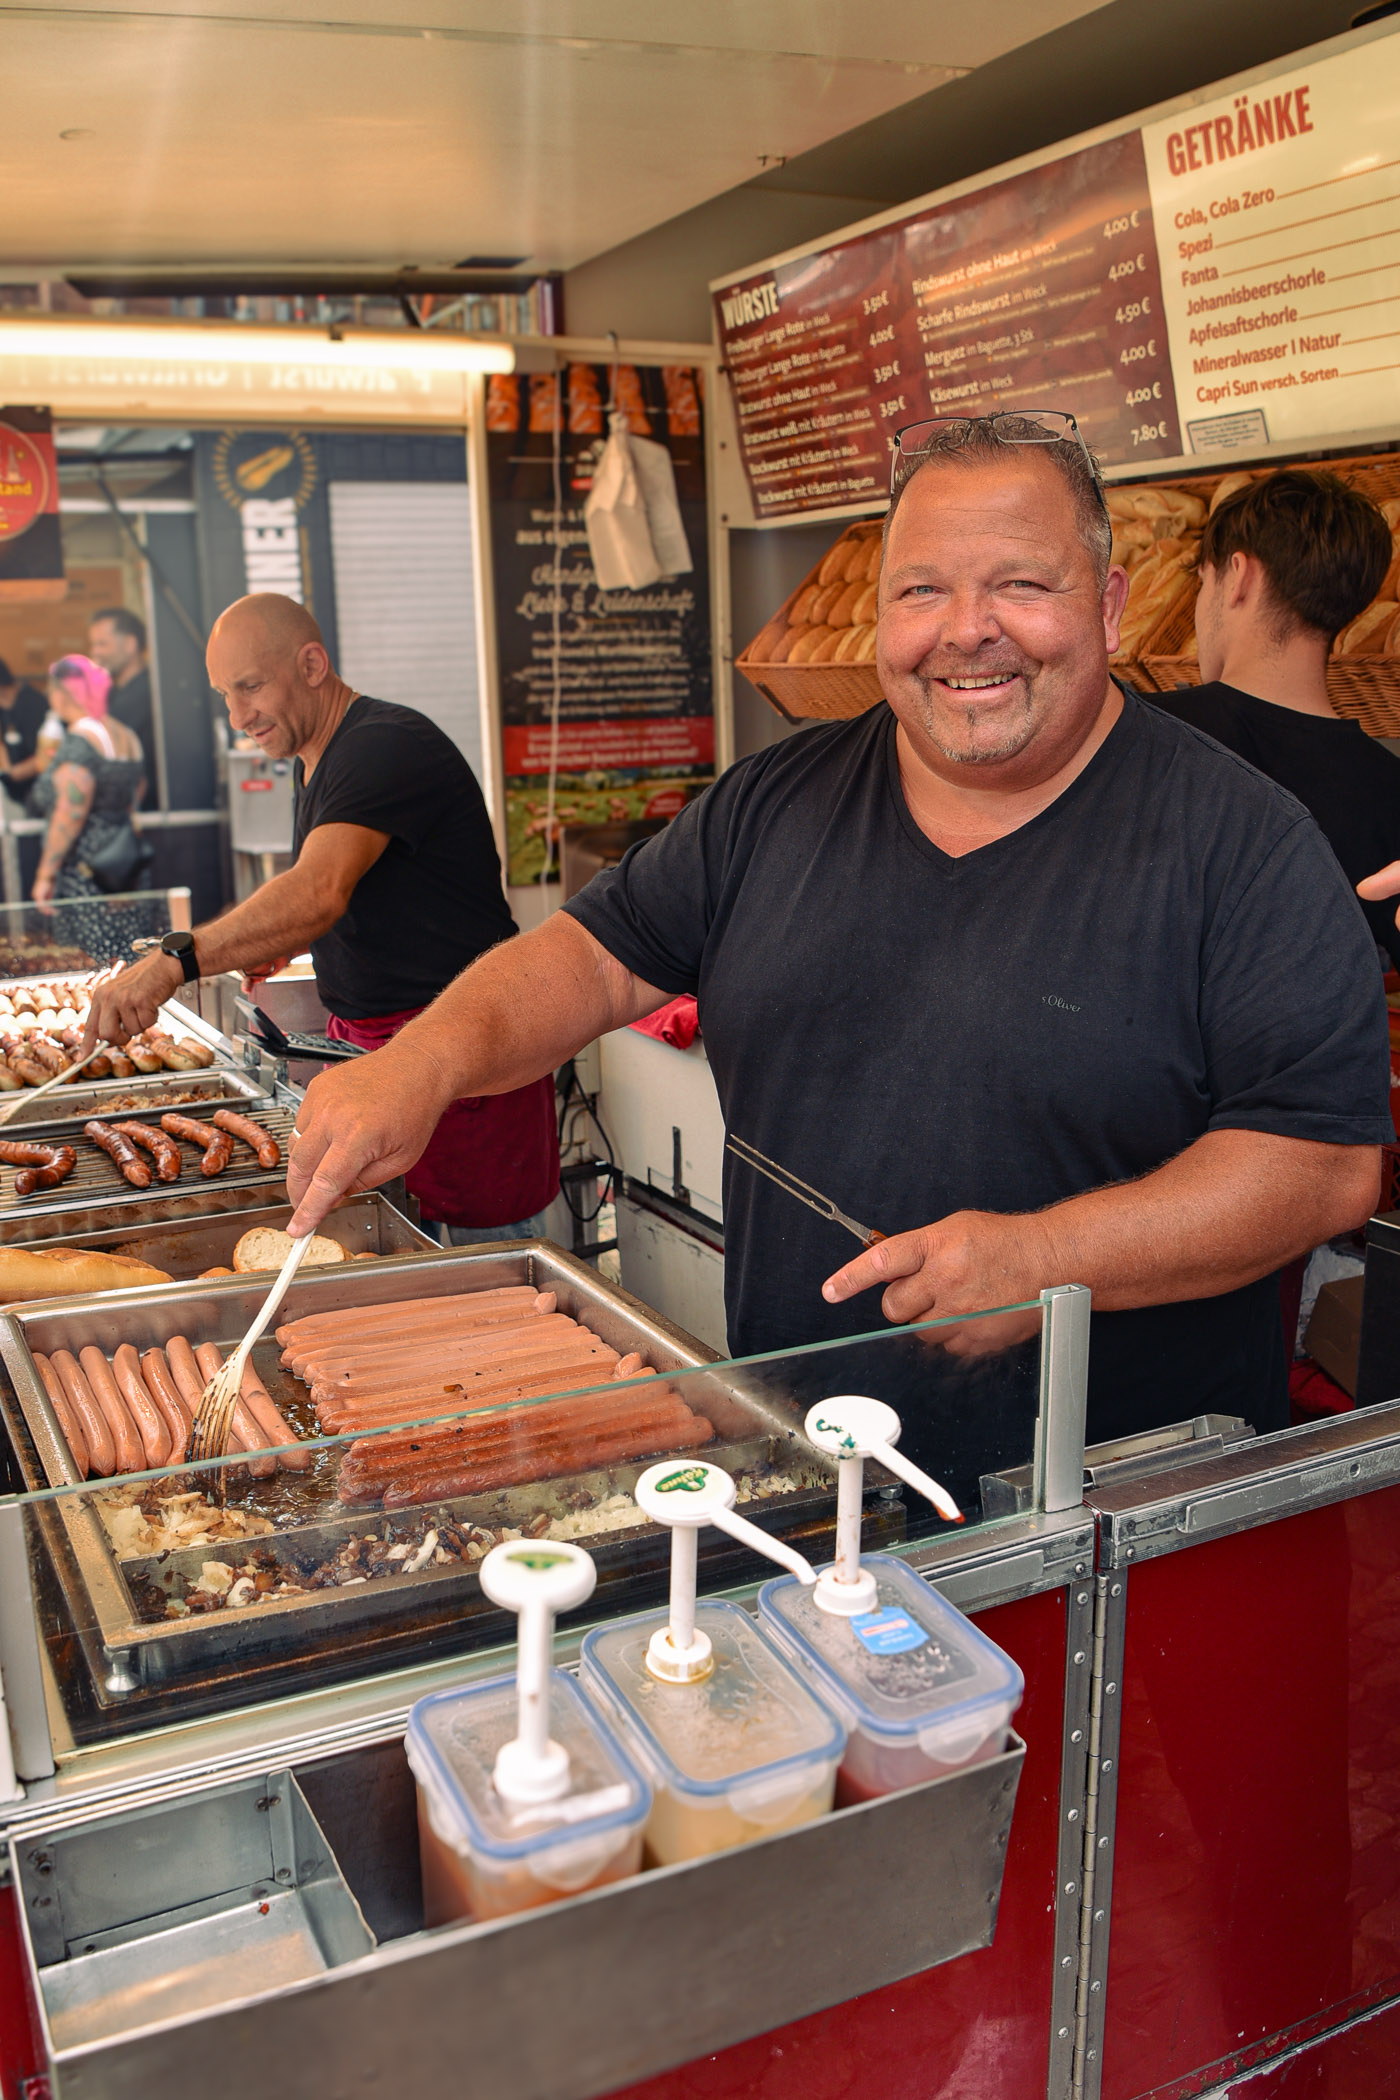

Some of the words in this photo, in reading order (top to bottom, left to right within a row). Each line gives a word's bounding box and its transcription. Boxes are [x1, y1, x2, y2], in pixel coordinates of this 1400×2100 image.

[1166, 85, 1314, 177] GETRÄNKE
[1174, 208, 1208, 230] Cola,
[1209, 196, 1240, 220] Cola
[1242, 188, 1275, 209] Zero
[912, 268, 966, 295] Rindswurst
[966, 260, 992, 279] ohne
[993, 249, 1019, 269] Haut
[1032, 238, 1056, 256] Weck
[1178, 233, 1214, 261] Spezi
[1181, 266, 1219, 288] Fanta
[1186, 268, 1326, 316] Johannisbeerschorle
[721, 281, 779, 330] WÜRSTE
[917, 308, 954, 331] Scharfe
[954, 293, 1011, 320] Rindswurst
[1023, 281, 1047, 300] Weck
[1189, 305, 1298, 346] Apfelsaftschorle
[925, 346, 966, 367] Merguez
[1193, 342, 1288, 375] Mineralwasser
[1299, 333, 1341, 354] Natur
[930, 380, 979, 403] Käsewurst
[990, 374, 1014, 389] Weck
[1196, 382, 1231, 404] Capri
[1232, 379, 1259, 397] Sun
[1260, 374, 1299, 391] versch.
[1300, 366, 1339, 385] Sorten
